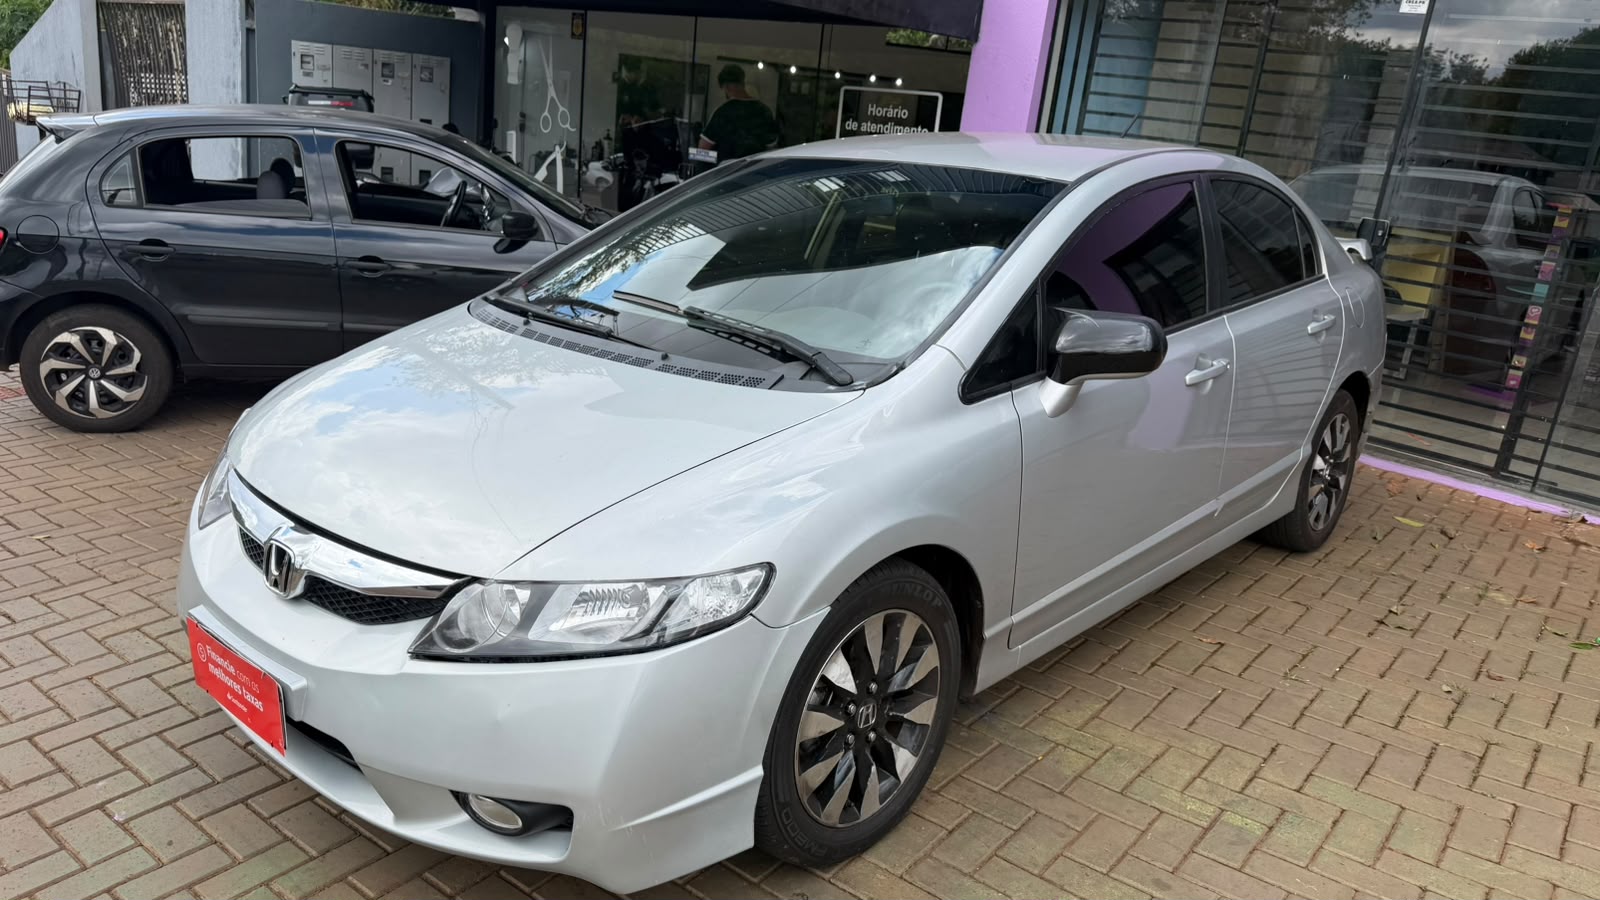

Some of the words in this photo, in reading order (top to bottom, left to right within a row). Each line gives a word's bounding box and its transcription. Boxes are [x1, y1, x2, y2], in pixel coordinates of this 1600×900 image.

[867, 103, 909, 119] Horário
[845, 118, 858, 131] de
[880, 583, 943, 607] UNLOP
[206, 644, 236, 676] Financie
[236, 670, 251, 687] com
[208, 662, 242, 695] melhores
[242, 685, 264, 712] taxas
